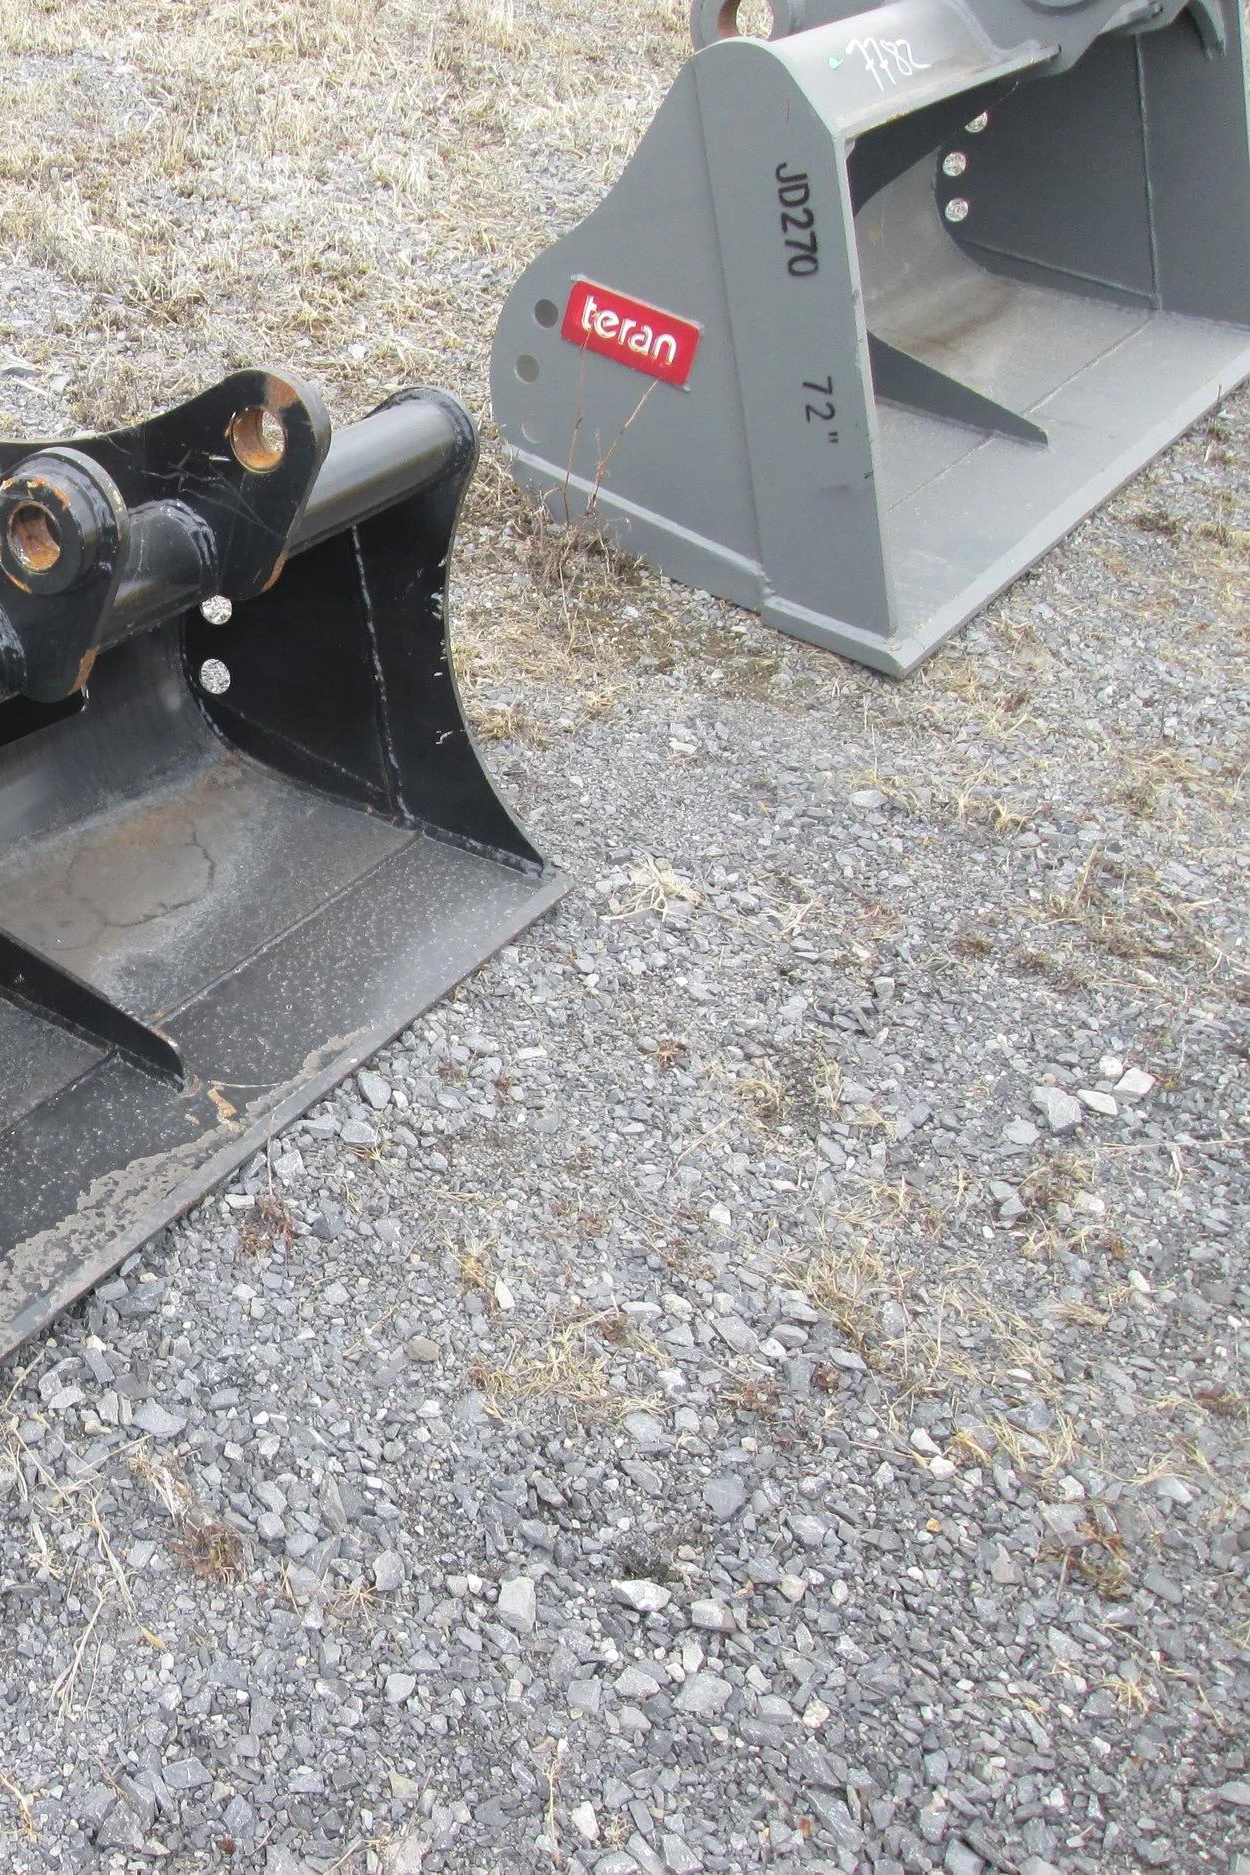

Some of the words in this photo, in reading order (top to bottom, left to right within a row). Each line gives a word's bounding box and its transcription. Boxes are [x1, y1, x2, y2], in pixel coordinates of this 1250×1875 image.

[844, 36, 932, 92] 7782
[775, 161, 819, 278] JD270
[581, 295, 677, 366] teran
